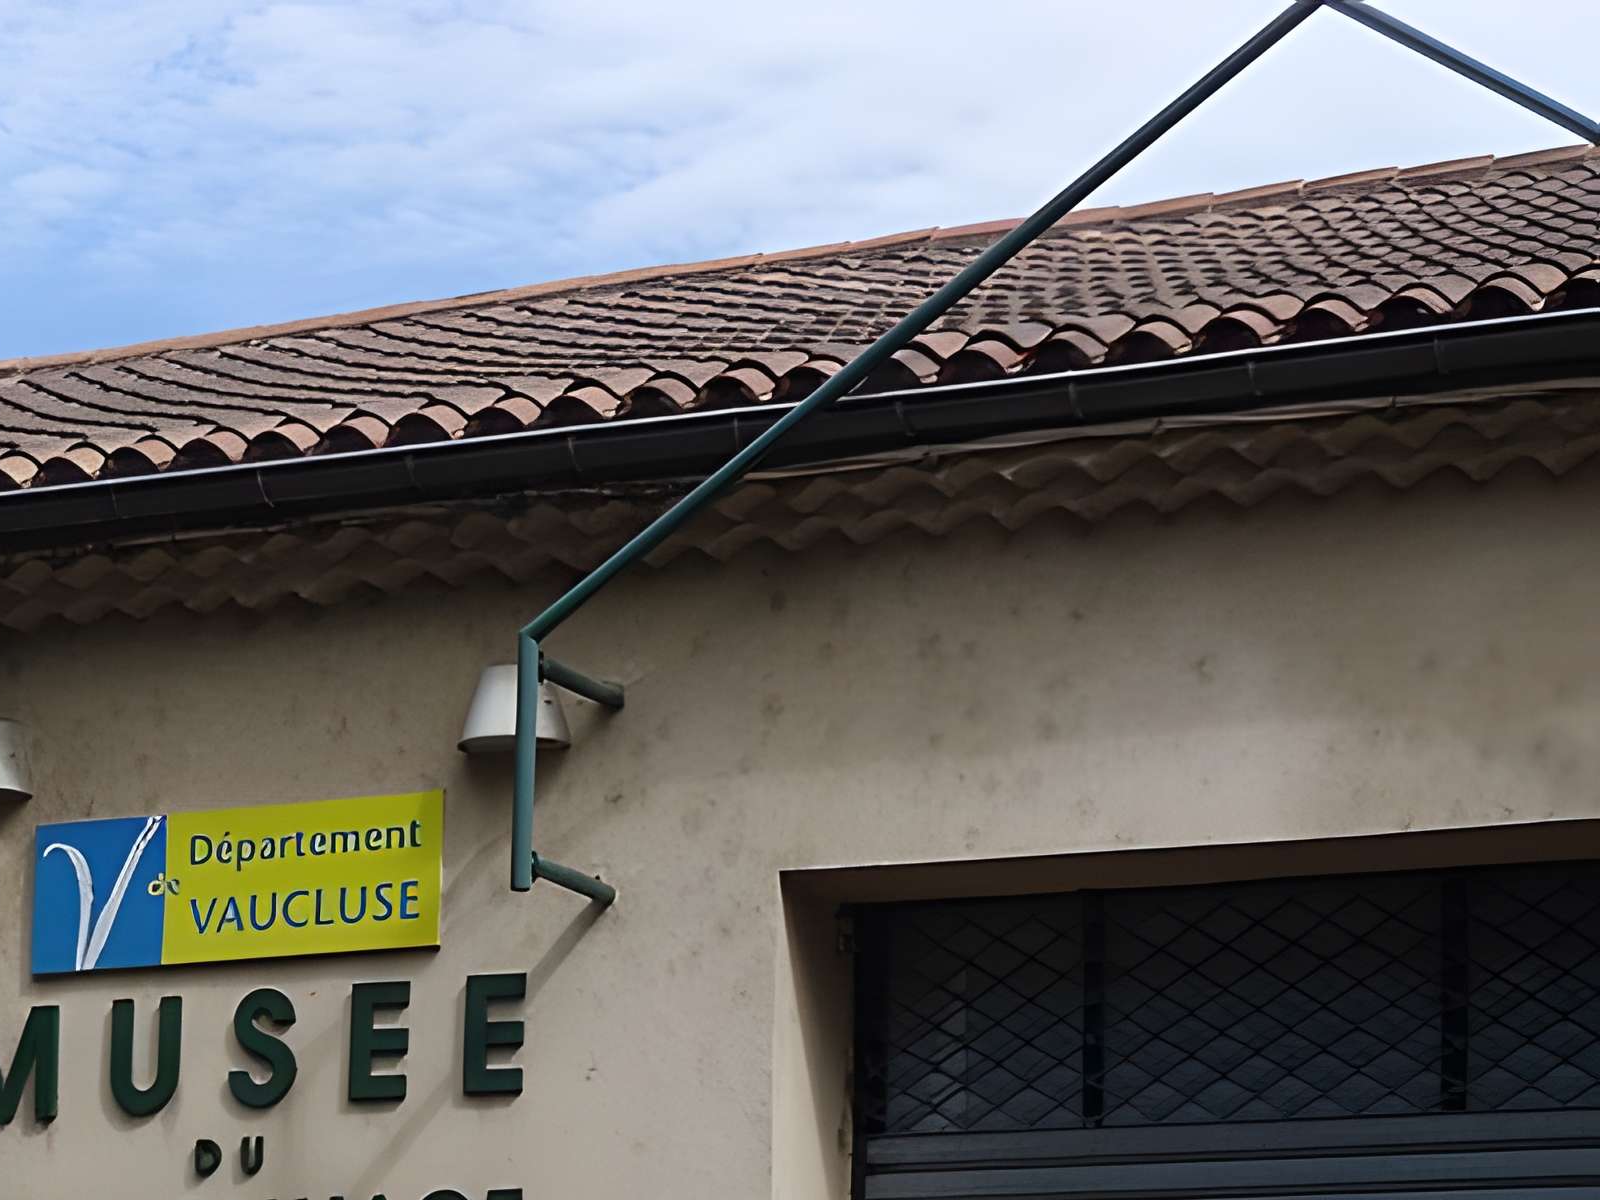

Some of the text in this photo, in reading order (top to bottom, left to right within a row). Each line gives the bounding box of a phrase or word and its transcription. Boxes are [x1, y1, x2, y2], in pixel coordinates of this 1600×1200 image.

[189, 818, 422, 871] Département
[189, 880, 420, 934] VAUCLUSE
[194, 1135, 264, 1177] DU
